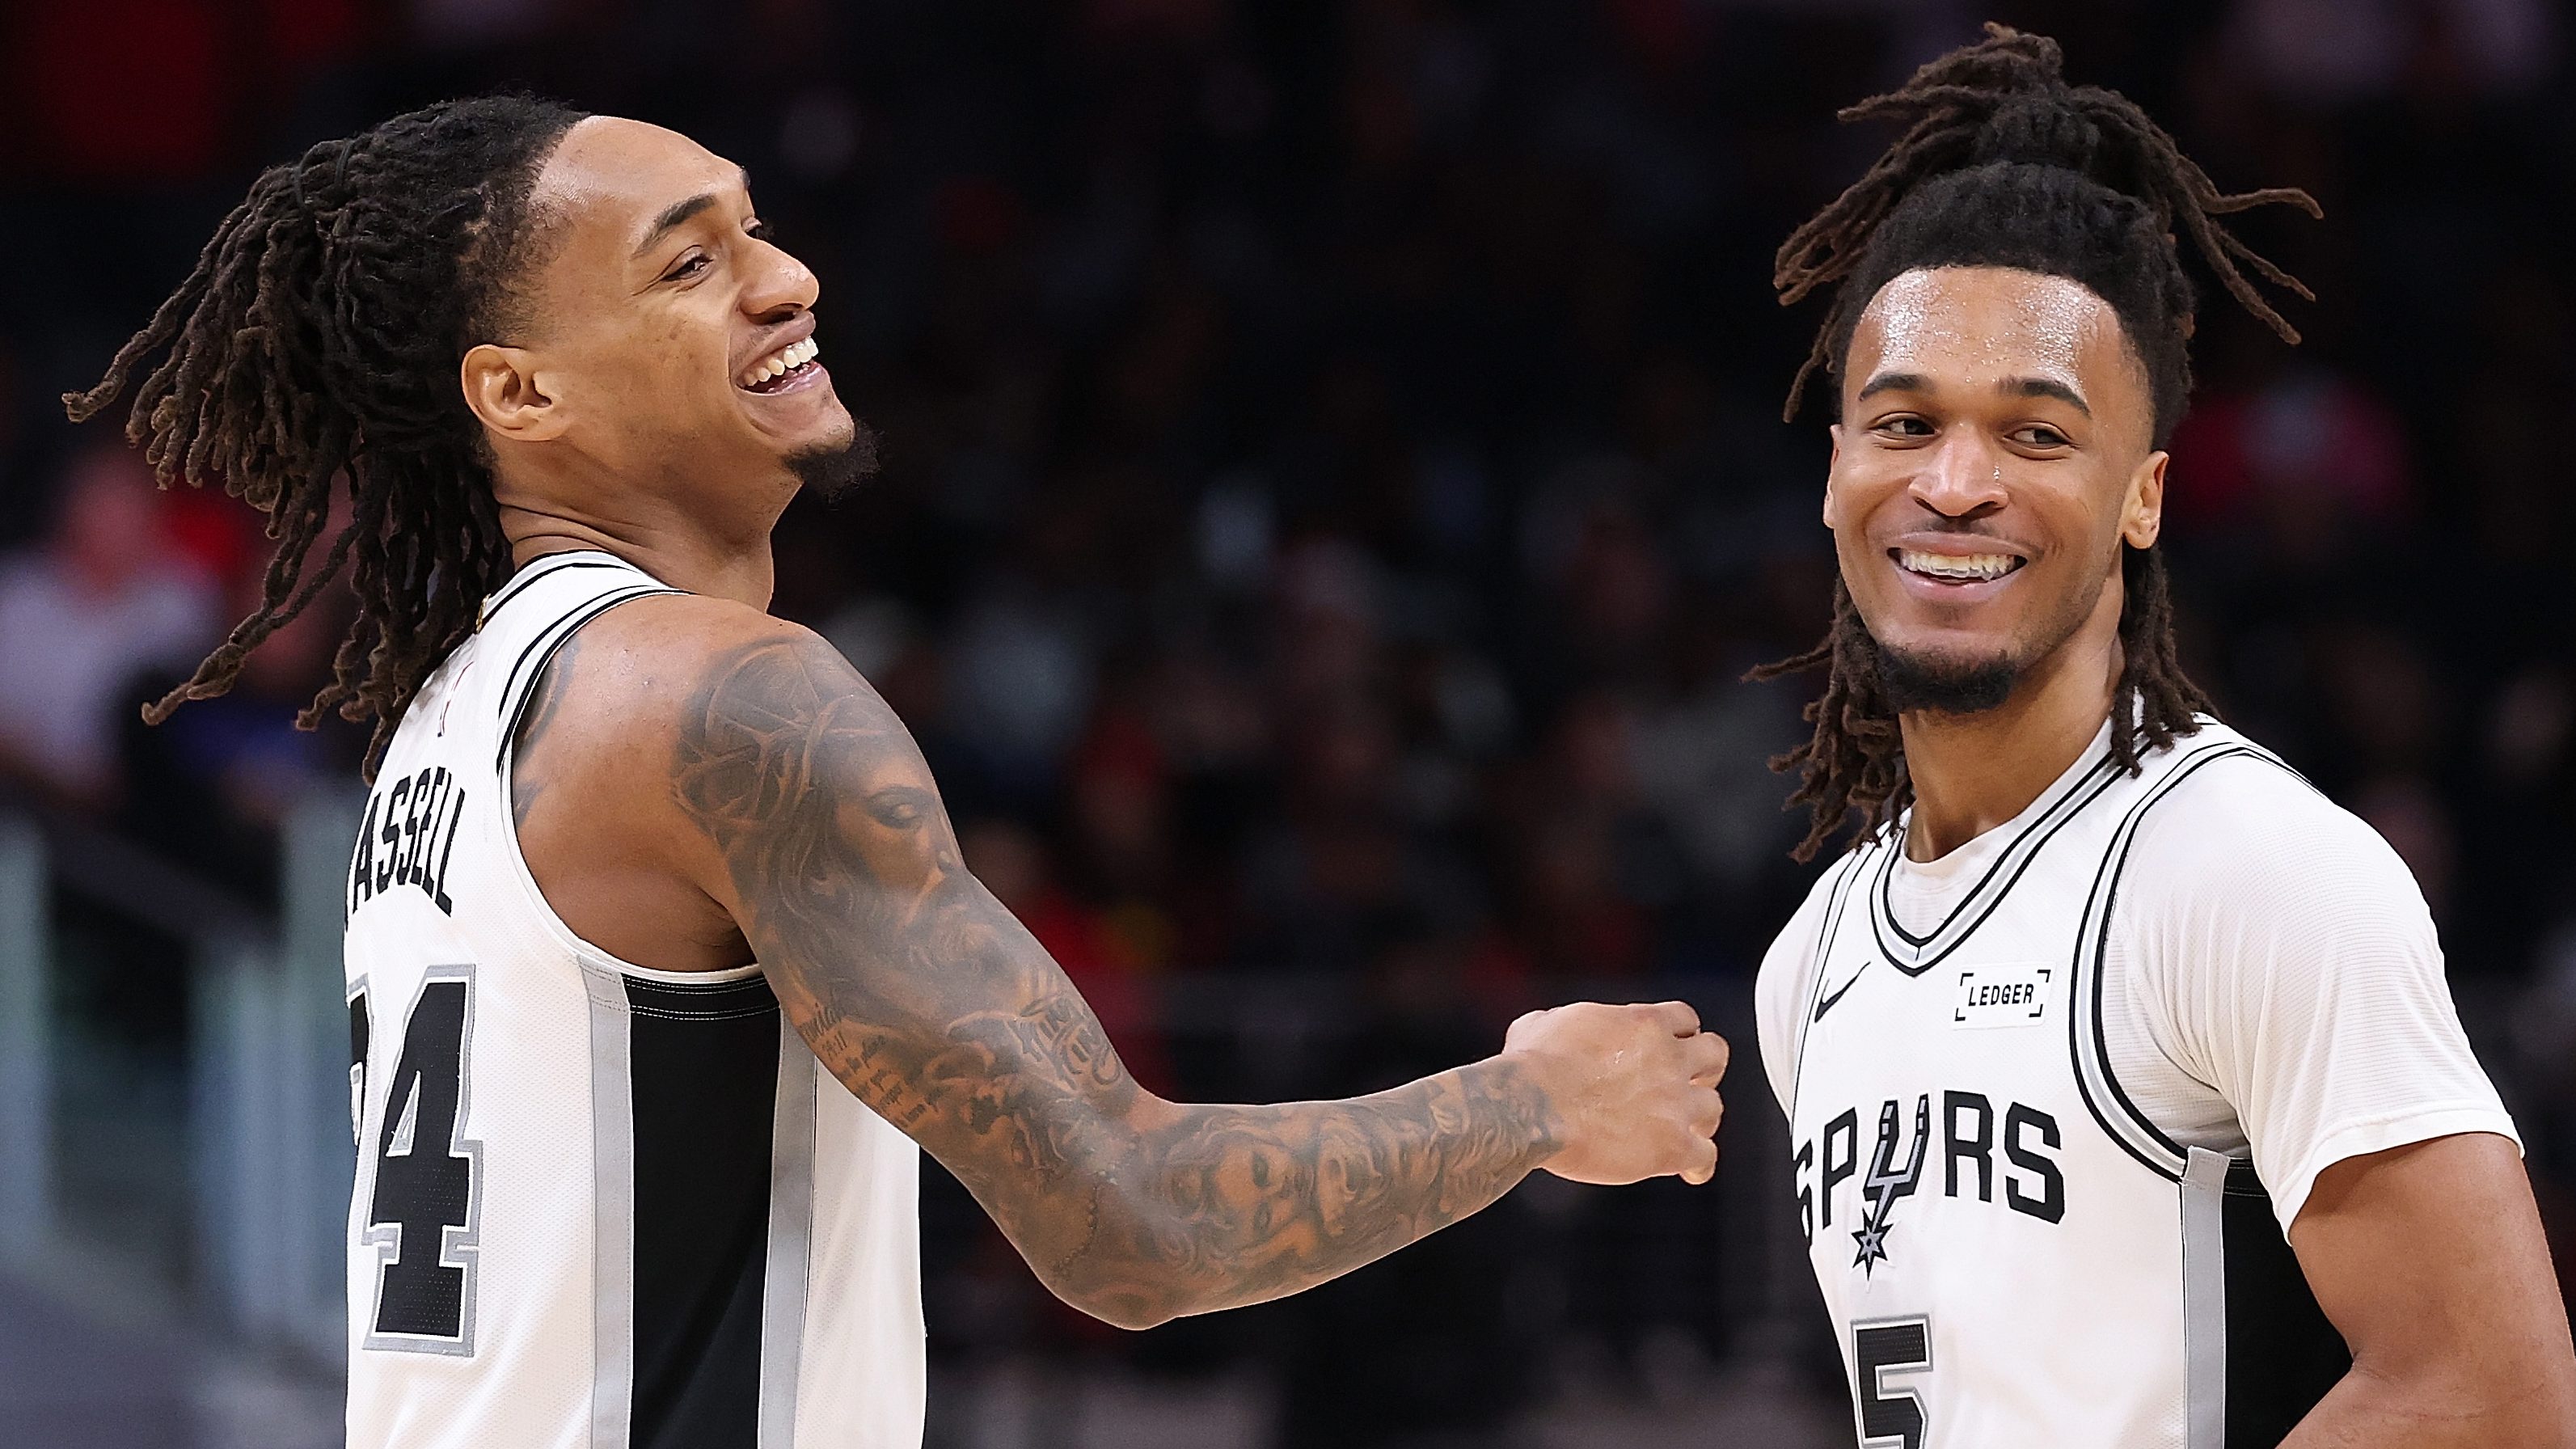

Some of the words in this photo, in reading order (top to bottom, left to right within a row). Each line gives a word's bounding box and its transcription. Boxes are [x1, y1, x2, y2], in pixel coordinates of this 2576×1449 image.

[348, 766, 466, 919] ASSELL
[1968, 984, 2034, 1007] LEDGER
[347, 963, 484, 1358] 4
[1792, 1090, 2065, 1281] SPURS
[1850, 1314, 1933, 1449] 5
